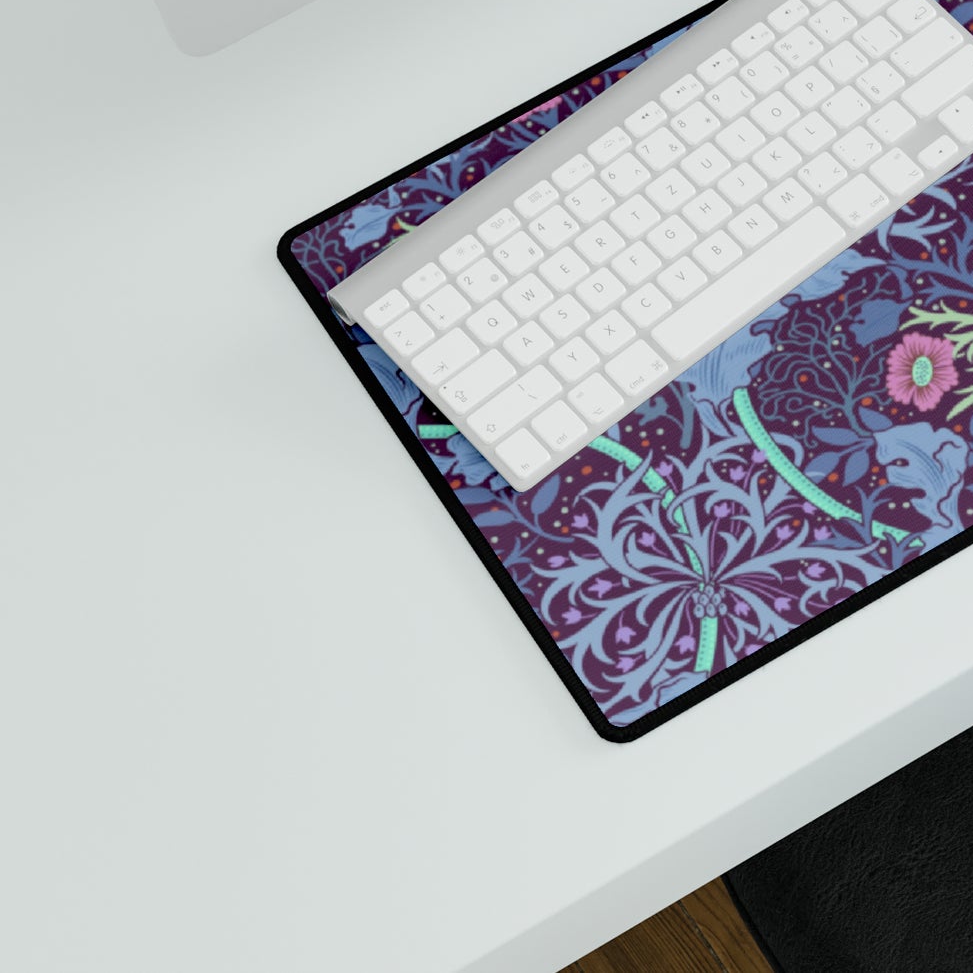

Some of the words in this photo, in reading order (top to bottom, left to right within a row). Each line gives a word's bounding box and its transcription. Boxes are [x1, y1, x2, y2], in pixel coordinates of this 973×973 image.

[426, 303, 436, 312] 1
[463, 275, 474, 286] 2
[499, 249, 510, 259] 3
[537, 222, 546, 232] 4
[571, 196, 581, 207] 5
[607, 171, 617, 180] 6
[640, 144, 650, 155] 7
[676, 119, 687, 129] 8
[711, 93, 721, 103] 9
[746, 68, 757, 77] 0
[486, 317, 499, 328] Q
[520, 288, 536, 302] W
[559, 263, 571, 274] E
[594, 237, 607, 248] R
[630, 210, 641, 220] T
[665, 184, 678, 196] Z
[700, 158, 713, 170] U
[770, 107, 783, 118] O
[804, 82, 814, 92] P
[521, 336, 534, 348] A
[557, 309, 568, 320] S
[592, 282, 605, 294] D
[628, 255, 638, 266] F
[664, 228, 676, 240] G
[698, 202, 712, 214] H
[736, 176, 745, 187] J
[769, 150, 783, 162] K
[804, 127, 816, 136] L
[567, 350, 578, 362] Y
[603, 324, 617, 337] X
[640, 297, 652, 308] C
[674, 270, 686, 281] V
[710, 245, 723, 256] B
[745, 217, 759, 230] N
[780, 191, 795, 204] M
